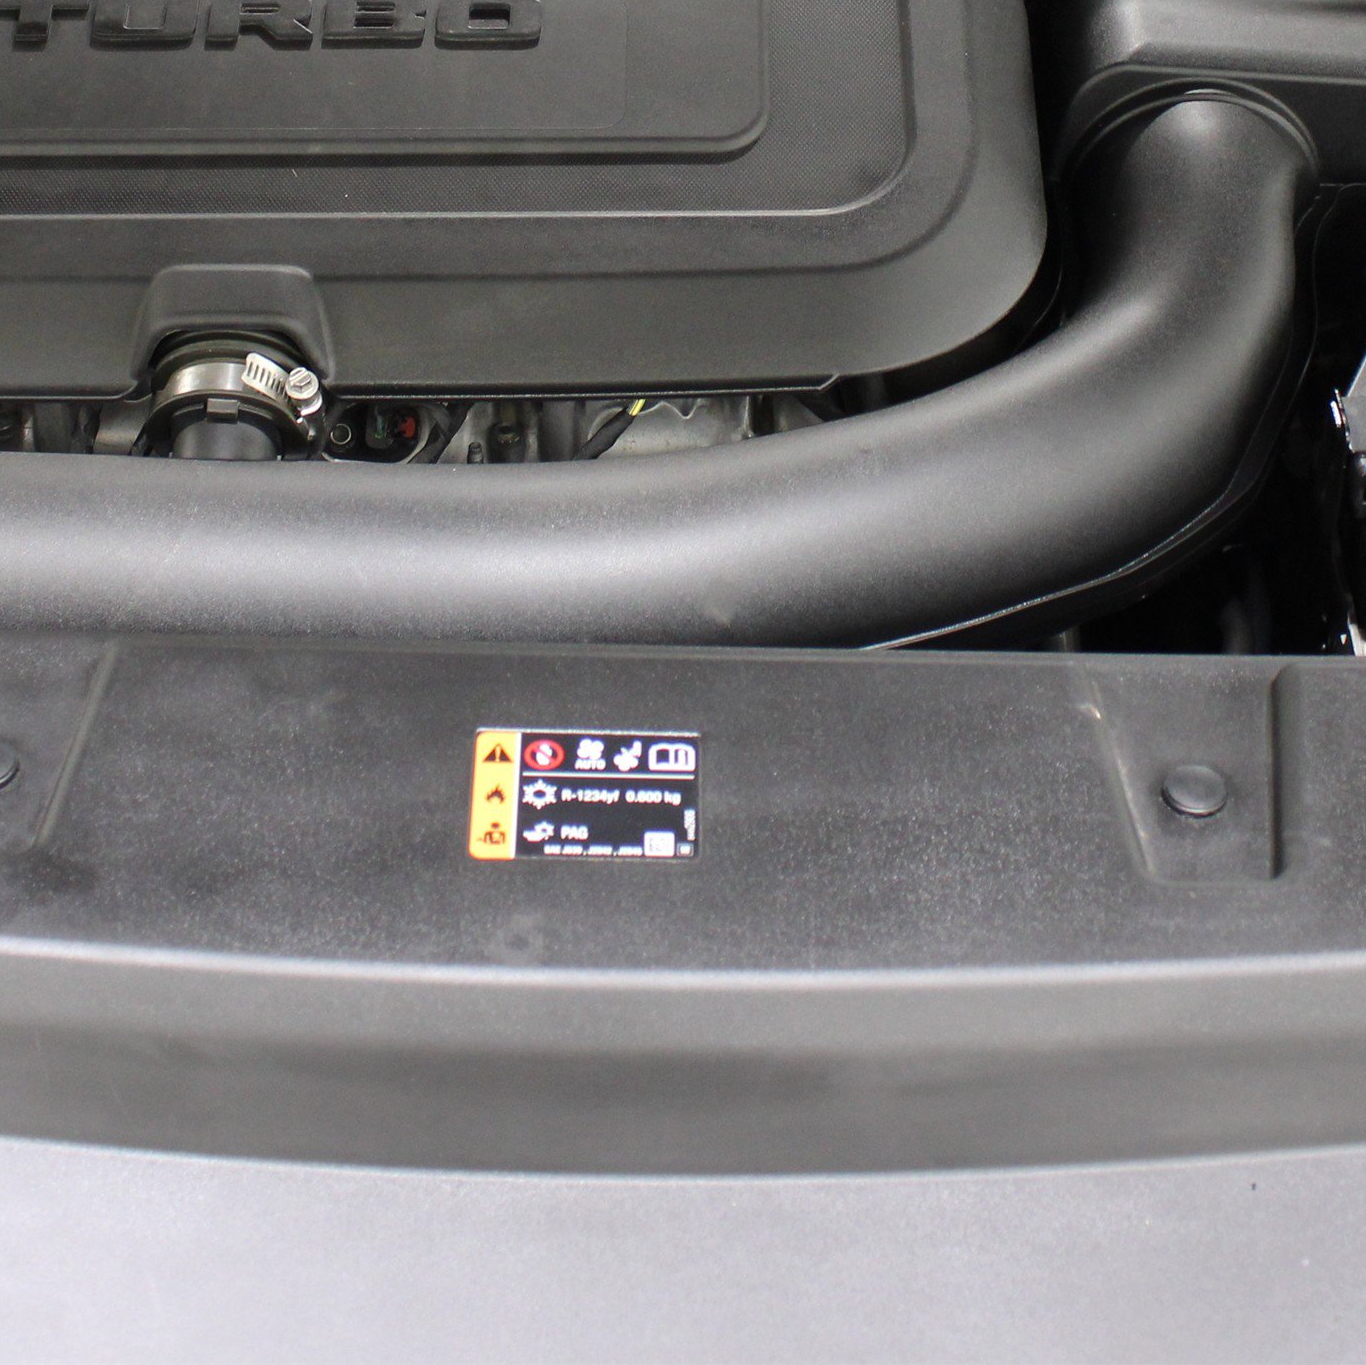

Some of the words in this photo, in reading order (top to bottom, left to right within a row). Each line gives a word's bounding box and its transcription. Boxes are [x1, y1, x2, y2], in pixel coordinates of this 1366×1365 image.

[575, 758, 606, 771] AUTO
[561, 788, 620, 805] R-1234yf
[663, 790, 682, 805] kg
[561, 824, 589, 840] PAG
